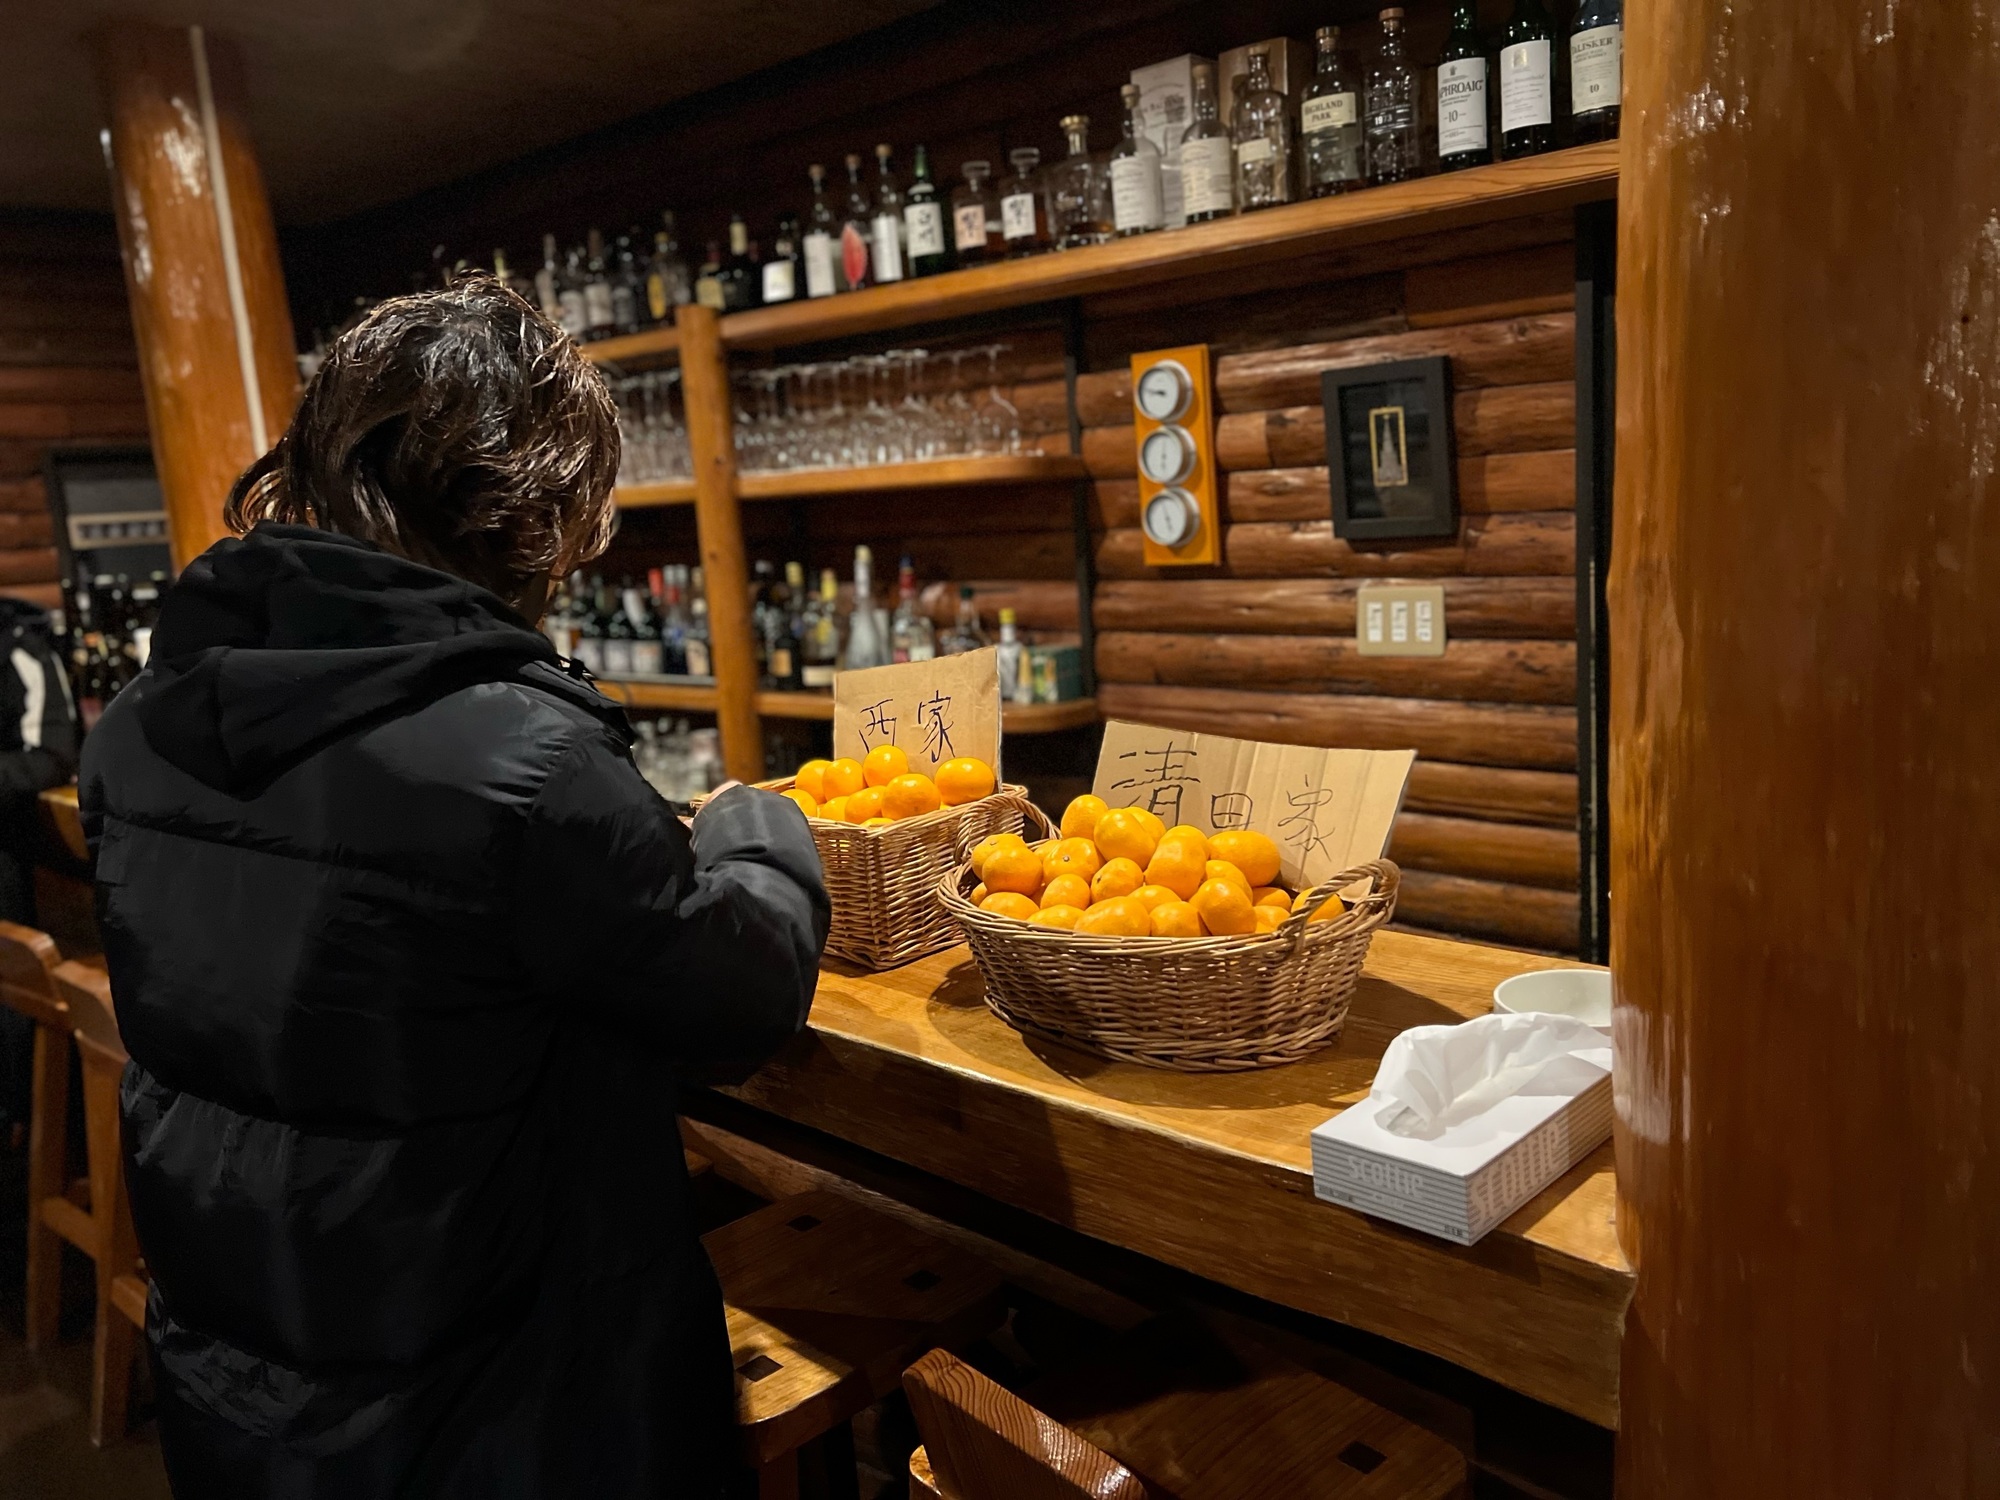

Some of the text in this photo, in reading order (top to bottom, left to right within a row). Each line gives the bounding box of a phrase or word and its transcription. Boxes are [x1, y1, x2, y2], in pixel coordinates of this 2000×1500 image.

[1590, 84, 1600, 94] 10
[1304, 99, 1343, 114] HIGHLAND
[1311, 113, 1332, 122] PARK
[1448, 110, 1459, 123] 10
